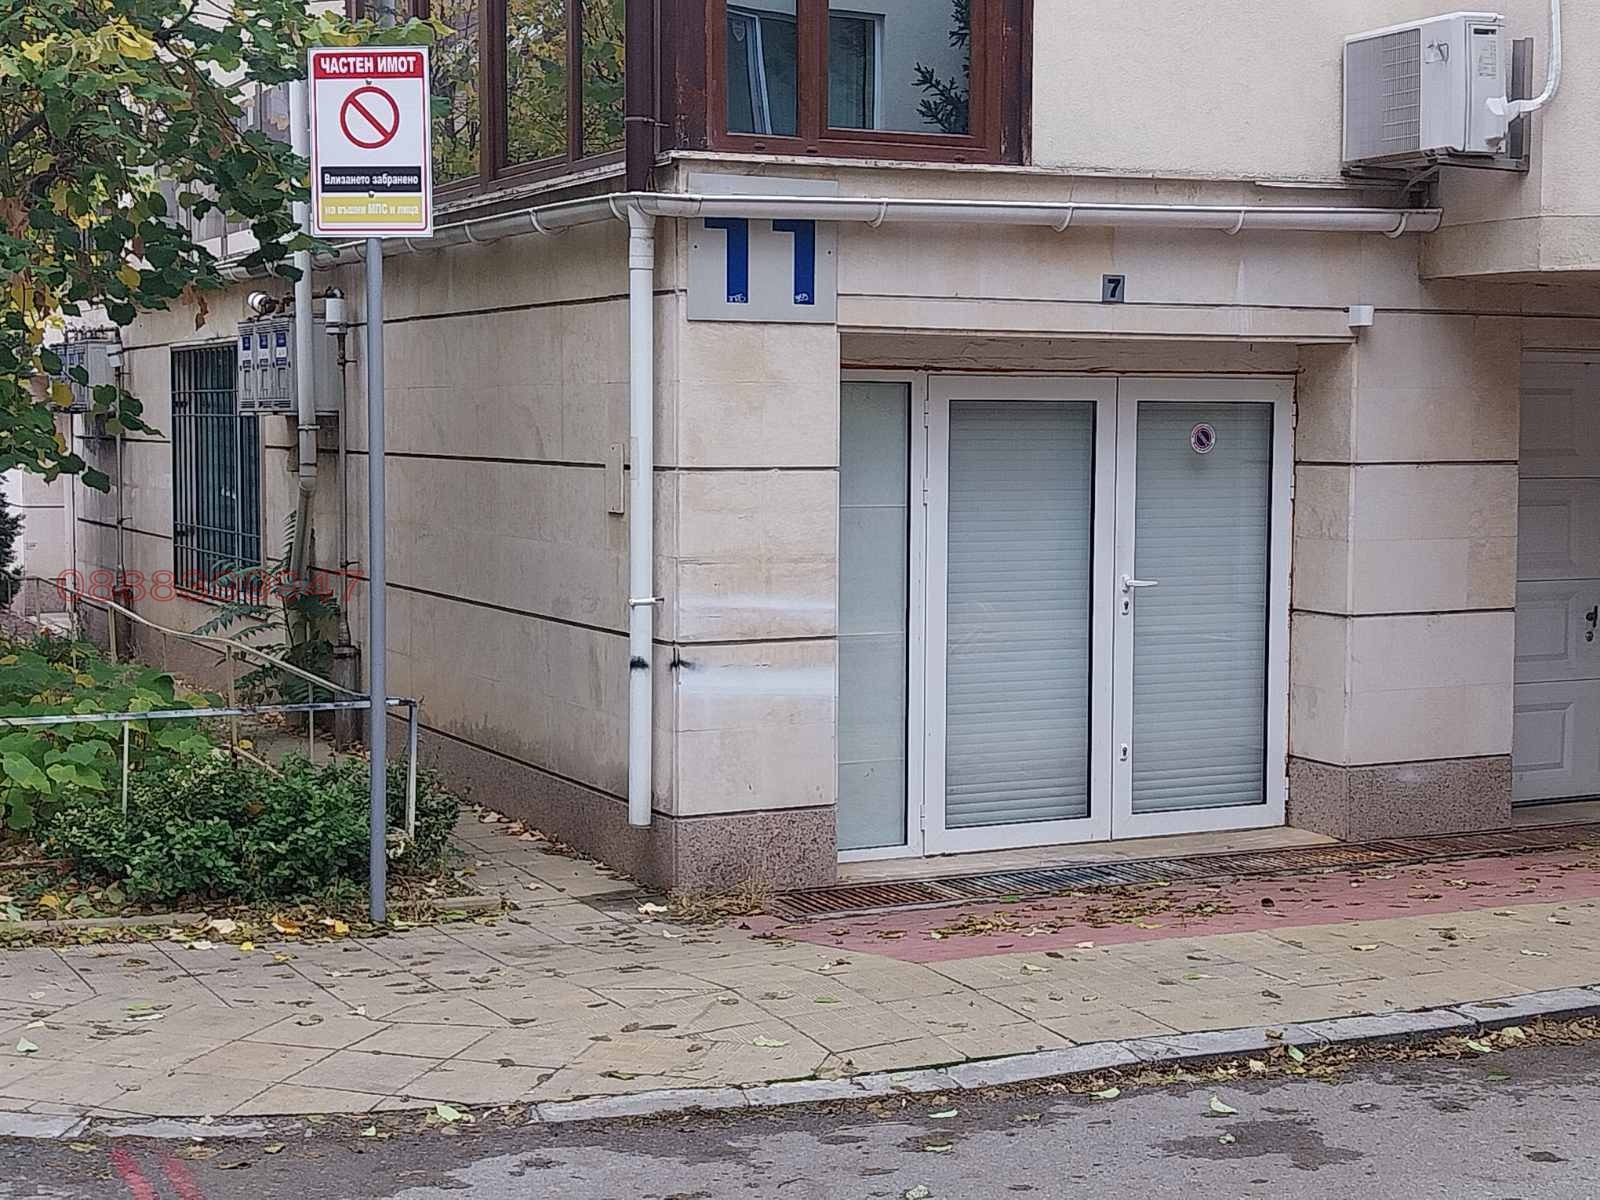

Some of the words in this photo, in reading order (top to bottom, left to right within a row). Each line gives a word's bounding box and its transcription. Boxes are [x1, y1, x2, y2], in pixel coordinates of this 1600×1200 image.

[320, 56, 374, 74] ЧАСТЕН
[377, 55, 417, 73] ИМОТ
[324, 173, 370, 185] Влизането
[372, 172, 419, 187] забранено
[1107, 278, 1122, 299] 7
